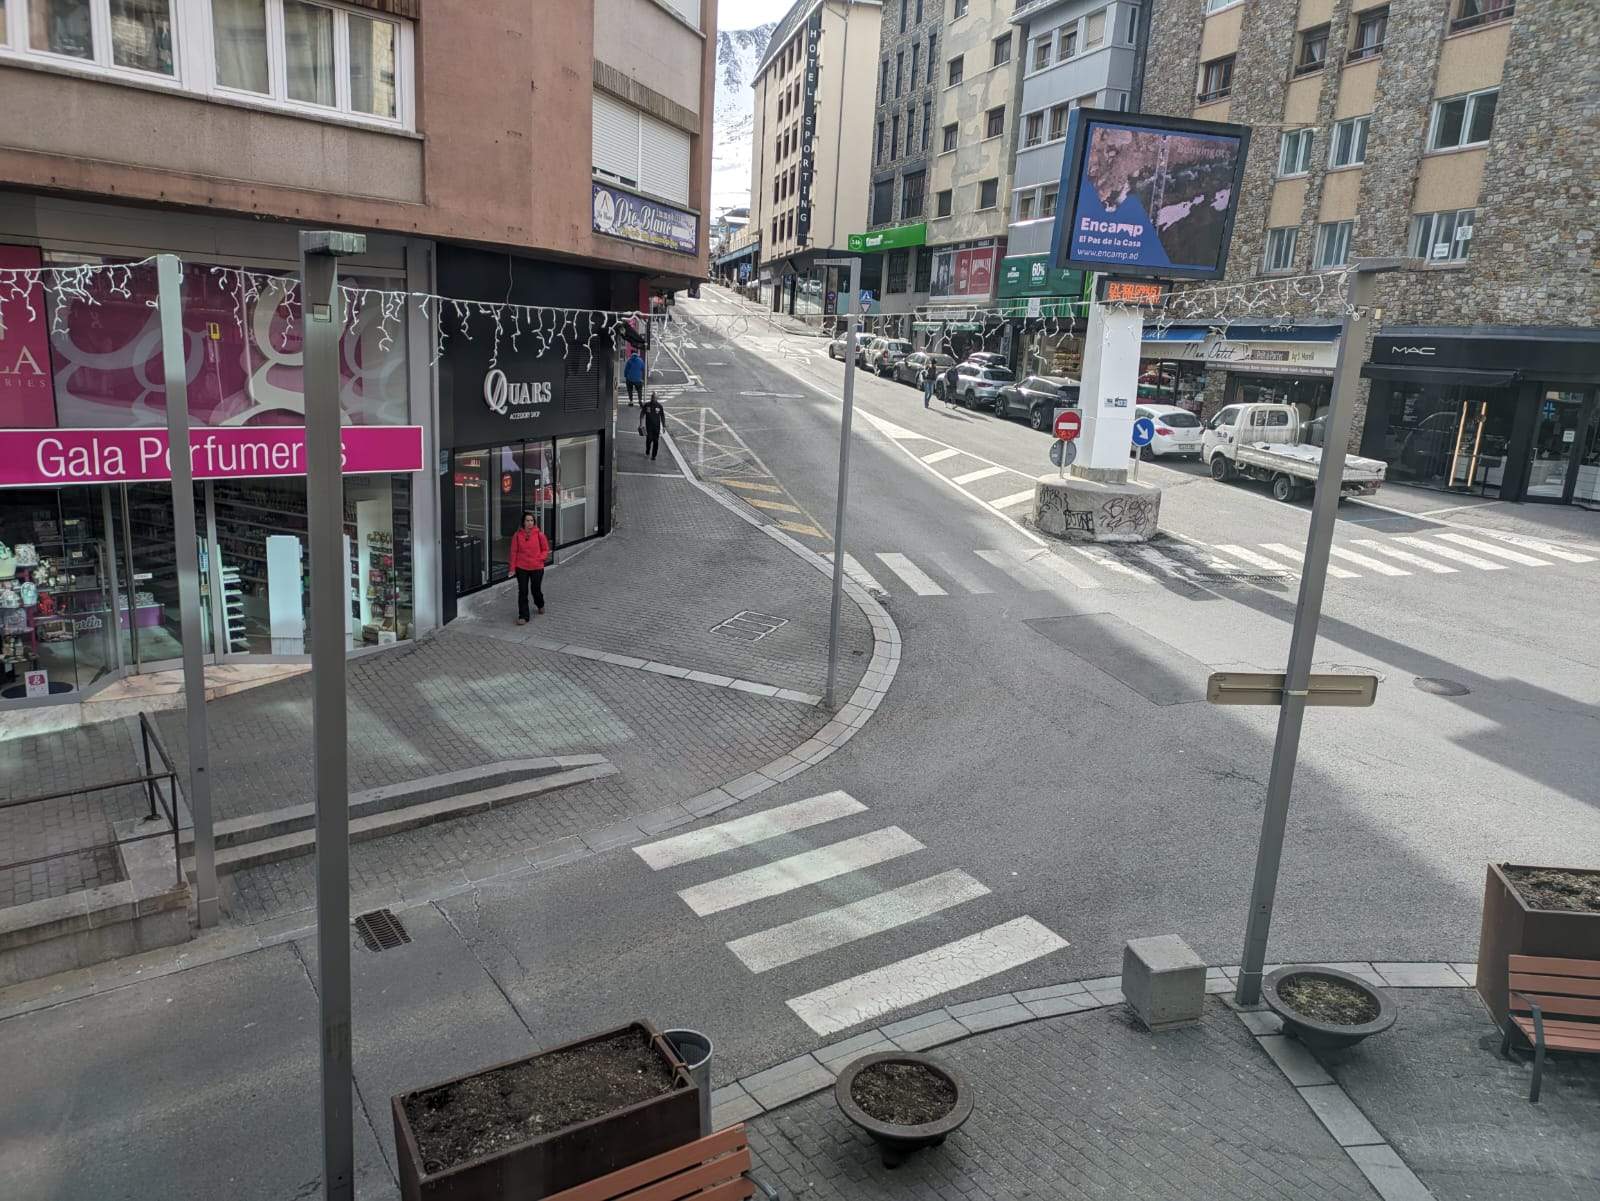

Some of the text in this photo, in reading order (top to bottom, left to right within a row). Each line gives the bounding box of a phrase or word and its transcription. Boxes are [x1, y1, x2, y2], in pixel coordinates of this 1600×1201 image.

[807, 29, 817, 96] HOTEL
[800, 116, 814, 222] SPORTING
[1079, 235, 1087, 243] El
[1087, 236, 1101, 244] Pas
[1113, 238, 1122, 246] la
[1122, 239, 1142, 248] Casa
[1081, 217, 1144, 238] Encamp
[1077, 248, 1139, 260] www.encamp.ad
[1391, 346, 1436, 355] MAC
[483, 368, 552, 415] QUARS
[36, 438, 125, 478] Gala
